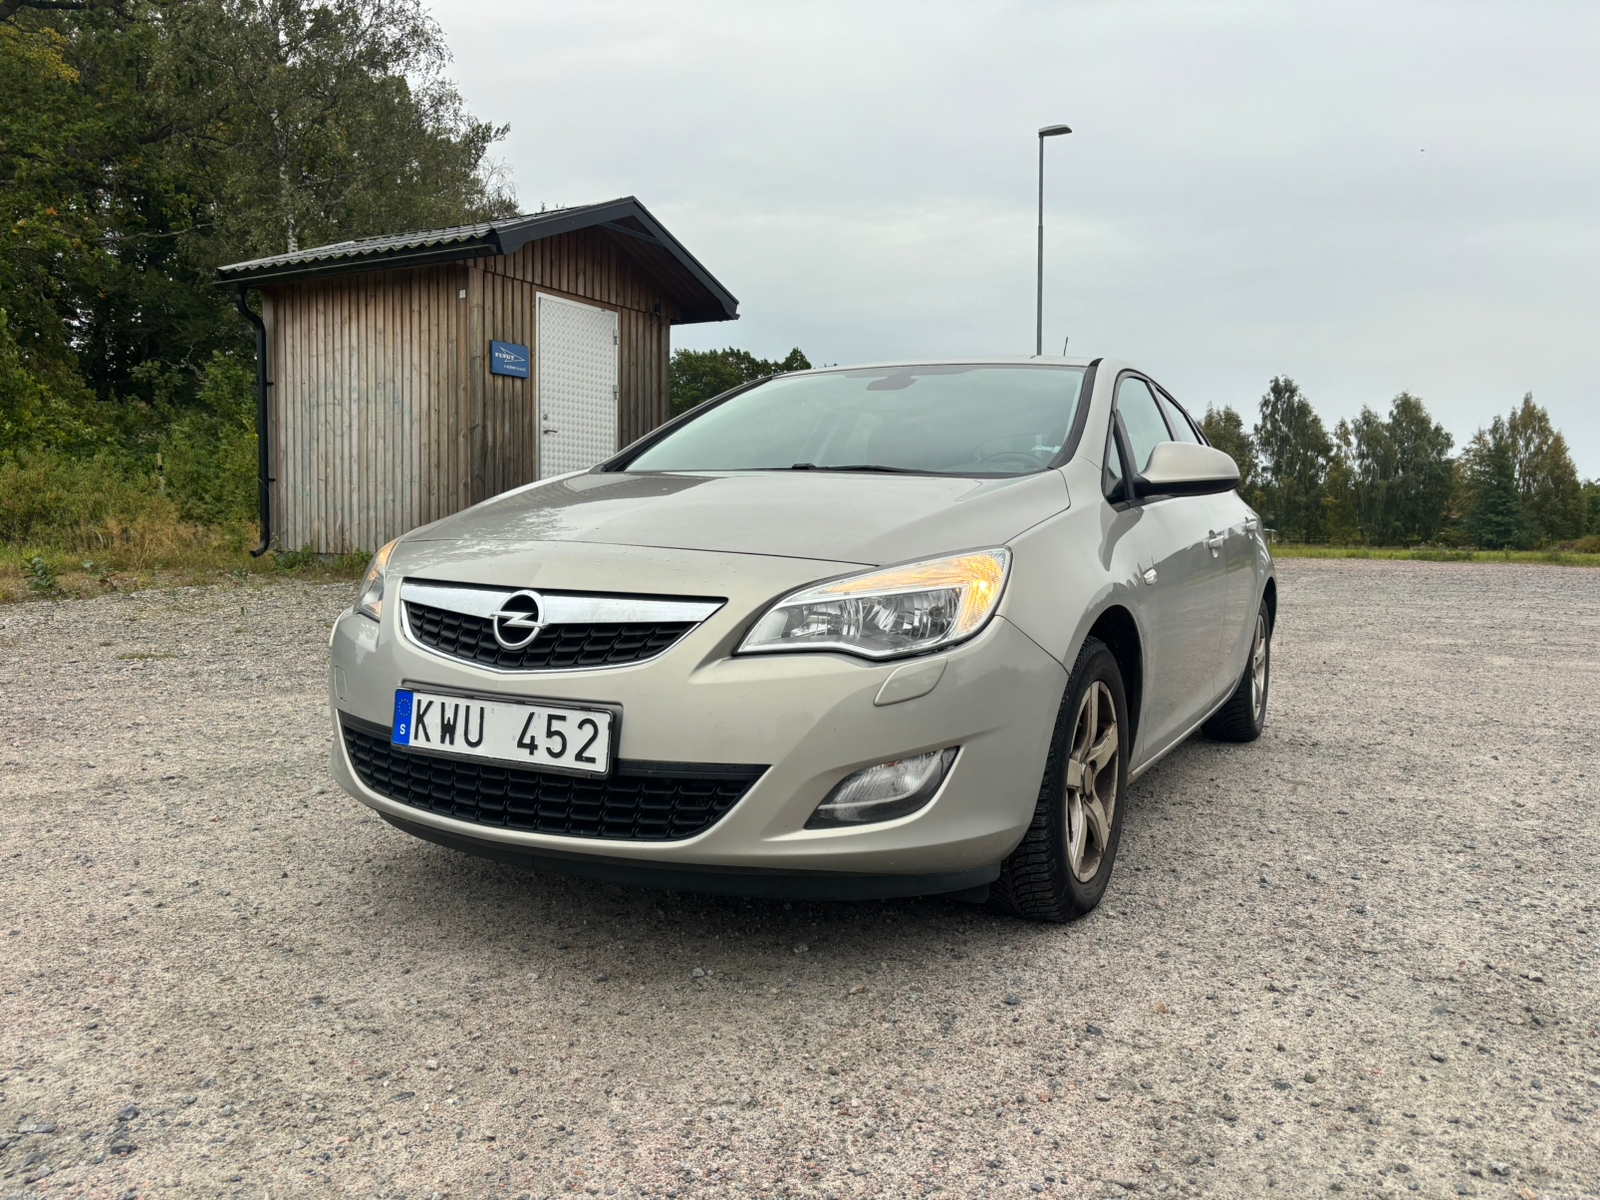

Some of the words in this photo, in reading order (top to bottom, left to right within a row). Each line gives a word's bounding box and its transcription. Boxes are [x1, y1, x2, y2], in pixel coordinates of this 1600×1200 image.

[495, 352, 515, 360] FLYGT
[399, 723, 406, 735] S
[413, 699, 485, 748] KWU
[516, 711, 599, 764] 452
